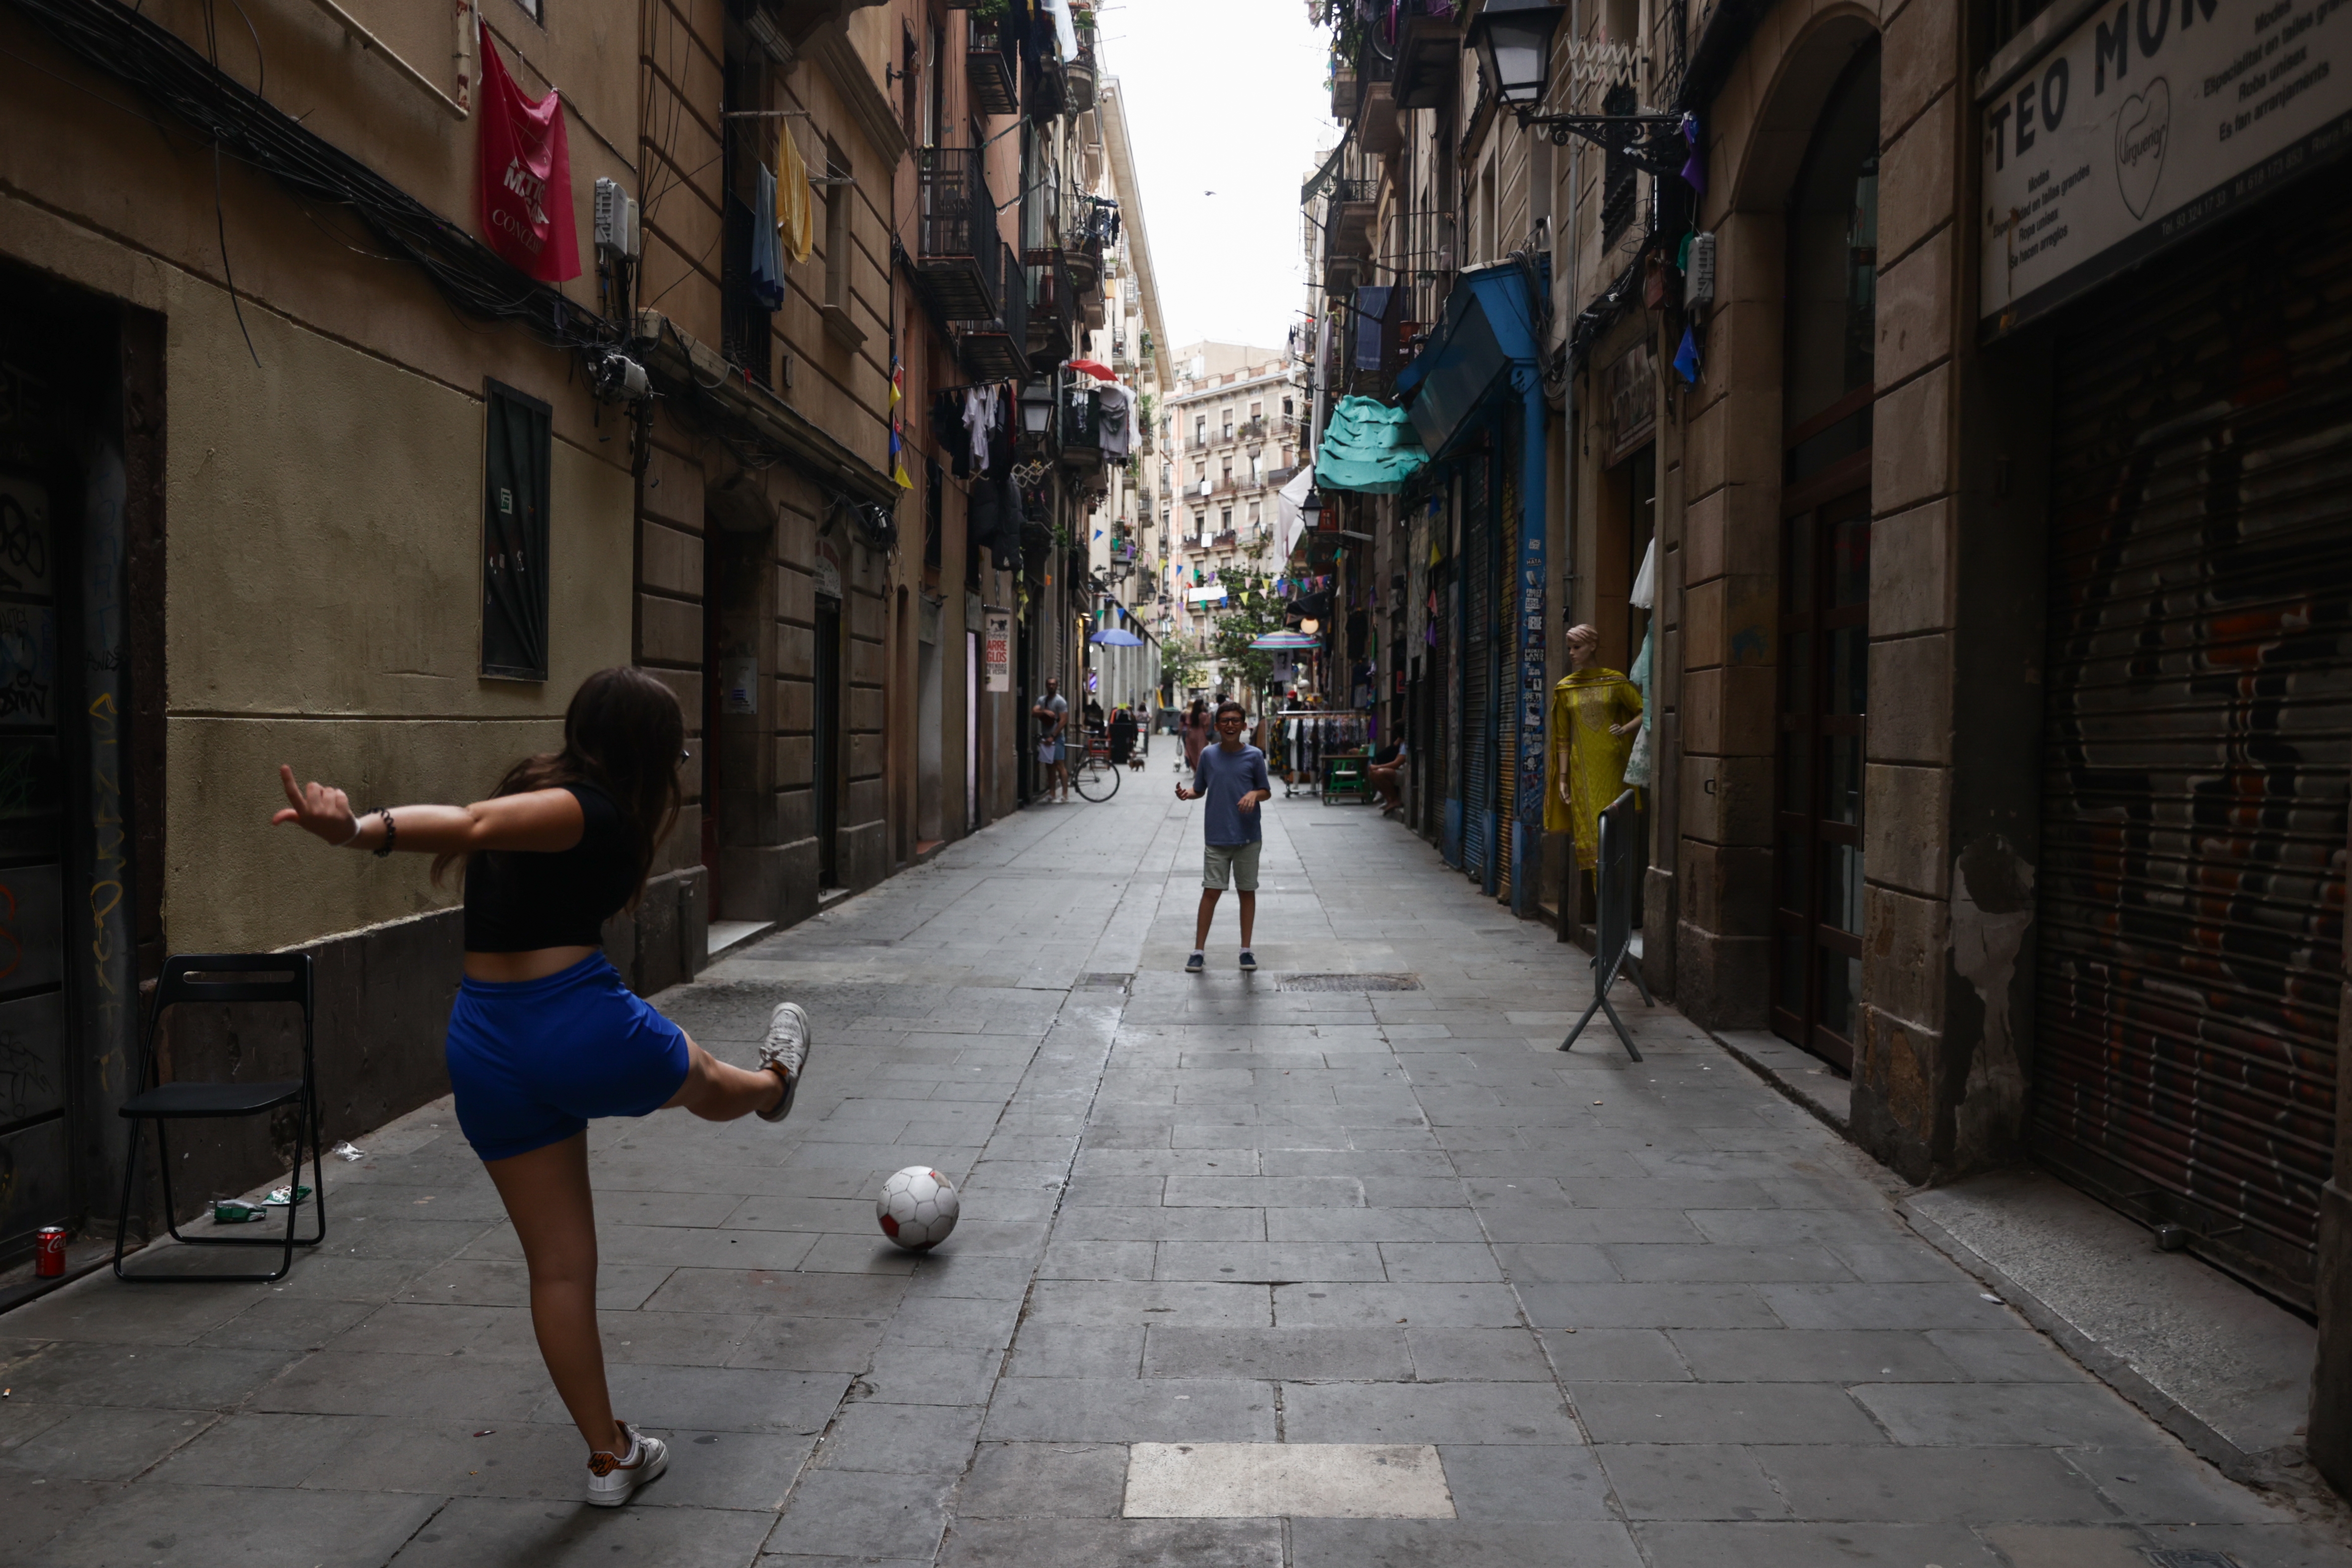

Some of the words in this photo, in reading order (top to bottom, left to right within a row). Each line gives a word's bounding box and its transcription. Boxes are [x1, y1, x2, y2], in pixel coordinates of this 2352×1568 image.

[2204, 44, 2262, 98] Especialitat
[2265, 35, 2279, 56] en
[2282, 11, 2313, 44] talles
[2239, 74, 2266, 102] Roba
[2270, 45, 2307, 82] unisex
[1990, 57, 2068, 173] TEO
[2219, 123, 2232, 142] Es
[2235, 111, 2251, 132] fan
[2254, 61, 2329, 120] arranjaments
[2028, 169, 2049, 193] Modas
[2032, 198, 2040, 212] en
[2042, 184, 2060, 205] tallas
[2061, 165, 2090, 196] grandes
[2162, 219, 2174, 237] Tel.
[2176, 213, 2185, 229] 93
[2187, 203, 2201, 222] 324
[2204, 196, 2213, 212] 17
[2216, 190, 2226, 208] 33
[2248, 169, 2264, 190] 618
[2010, 254, 2018, 270] Se
[2019, 244, 2038, 263] hacen
[2040, 224, 2068, 251] arreglos
[2018, 224, 2035, 242] Ropa
[2036, 207, 2058, 231] unisex
[986, 652, 1007, 663] GLOS
[987, 640, 1007, 651] ARRE
